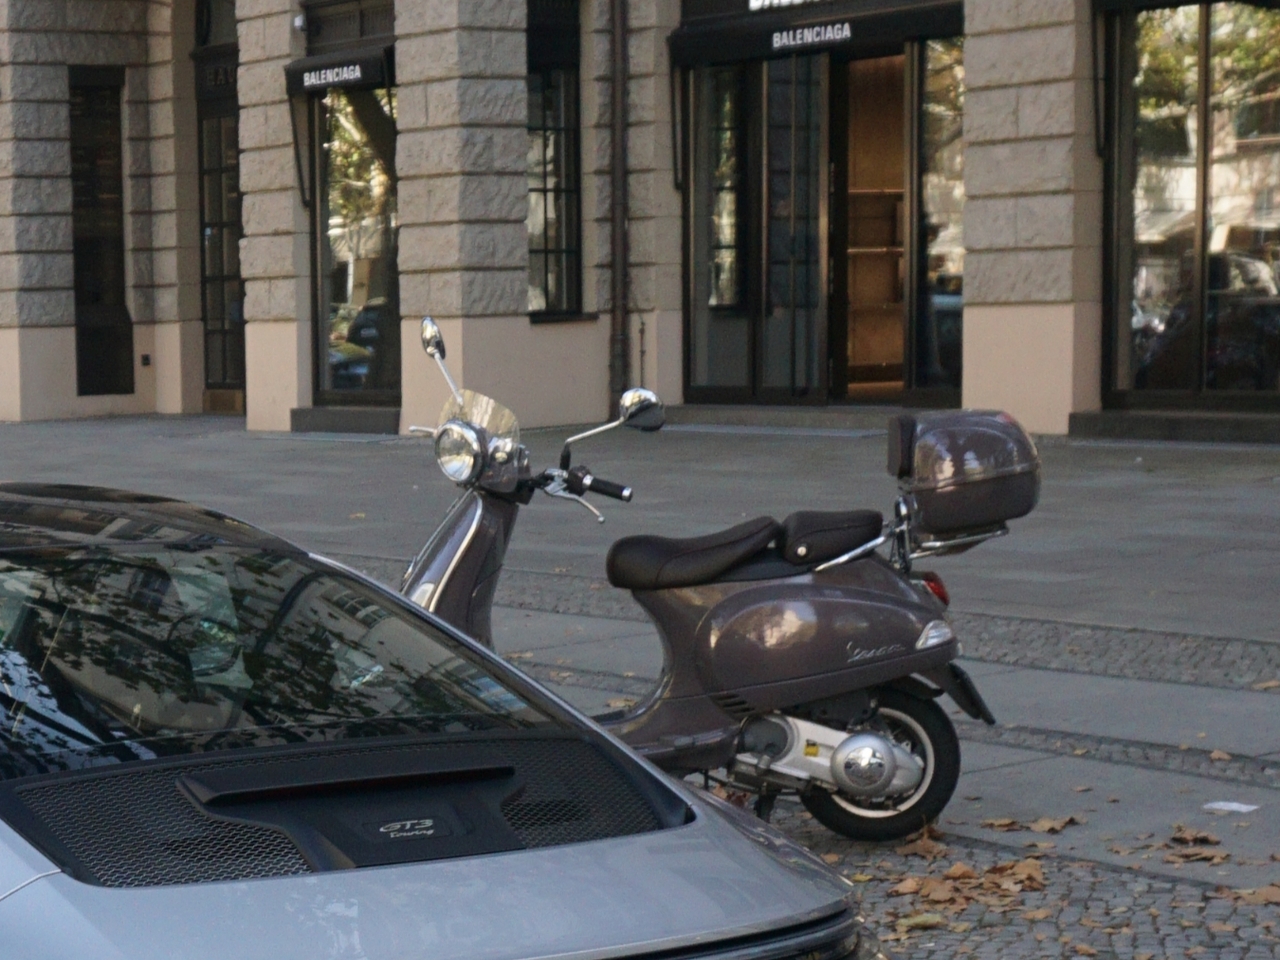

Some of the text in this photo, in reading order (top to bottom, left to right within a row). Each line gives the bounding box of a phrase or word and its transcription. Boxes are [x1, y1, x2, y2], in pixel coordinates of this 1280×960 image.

[772, 22, 851, 48] BALENCIAGA
[303, 64, 361, 86] BALENCIAGA
[379, 819, 434, 832] GT3
